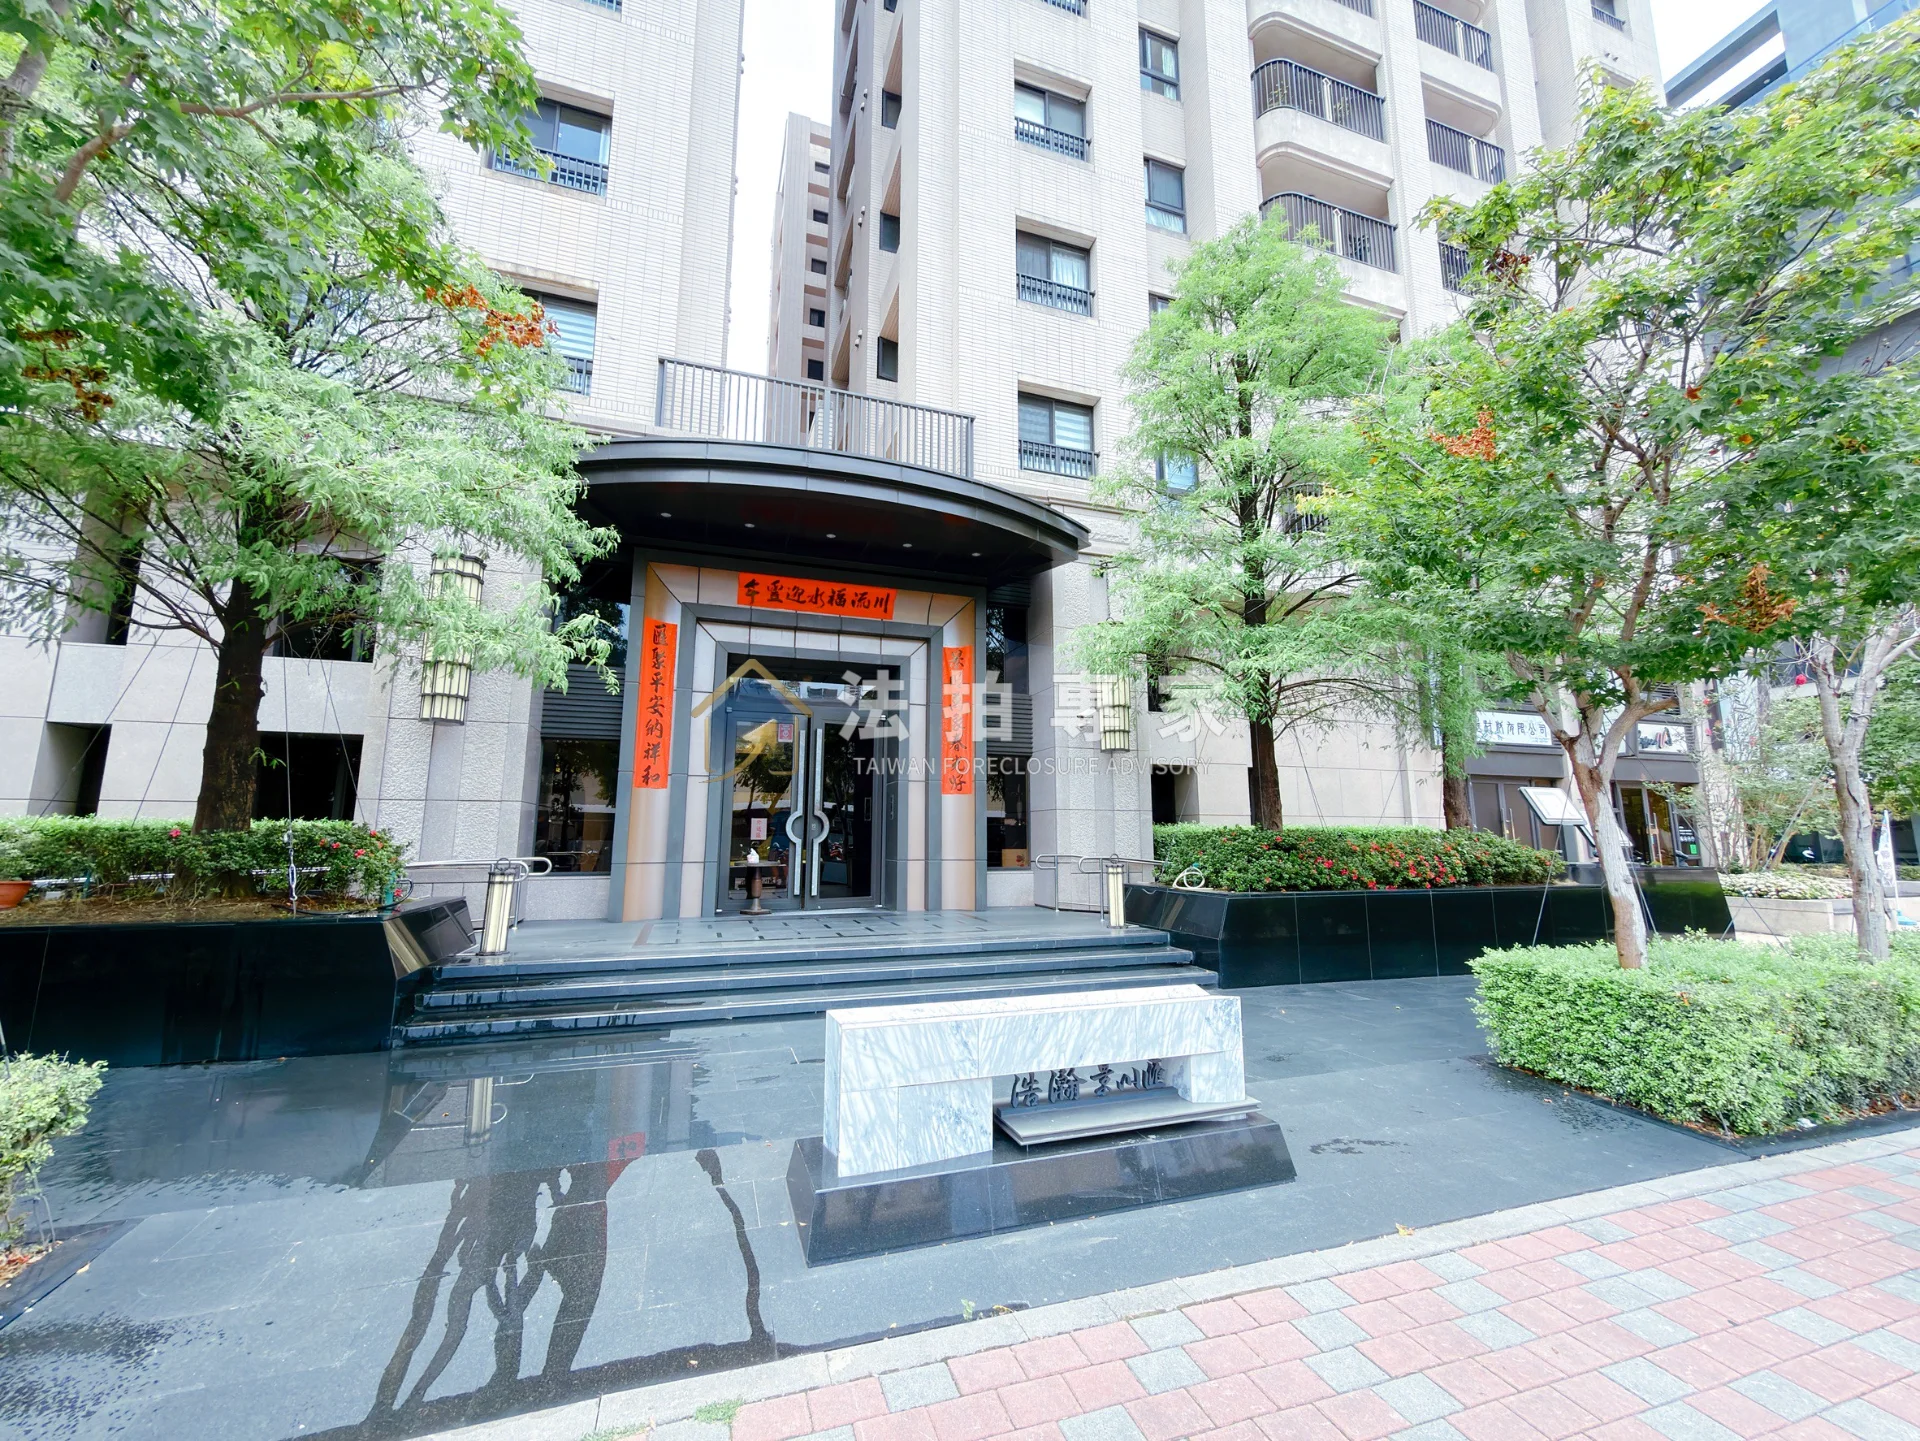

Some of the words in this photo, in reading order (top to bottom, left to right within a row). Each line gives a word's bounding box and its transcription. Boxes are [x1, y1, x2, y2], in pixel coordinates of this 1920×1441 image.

[641, 624, 667, 785] 匯聚平安納祥和
